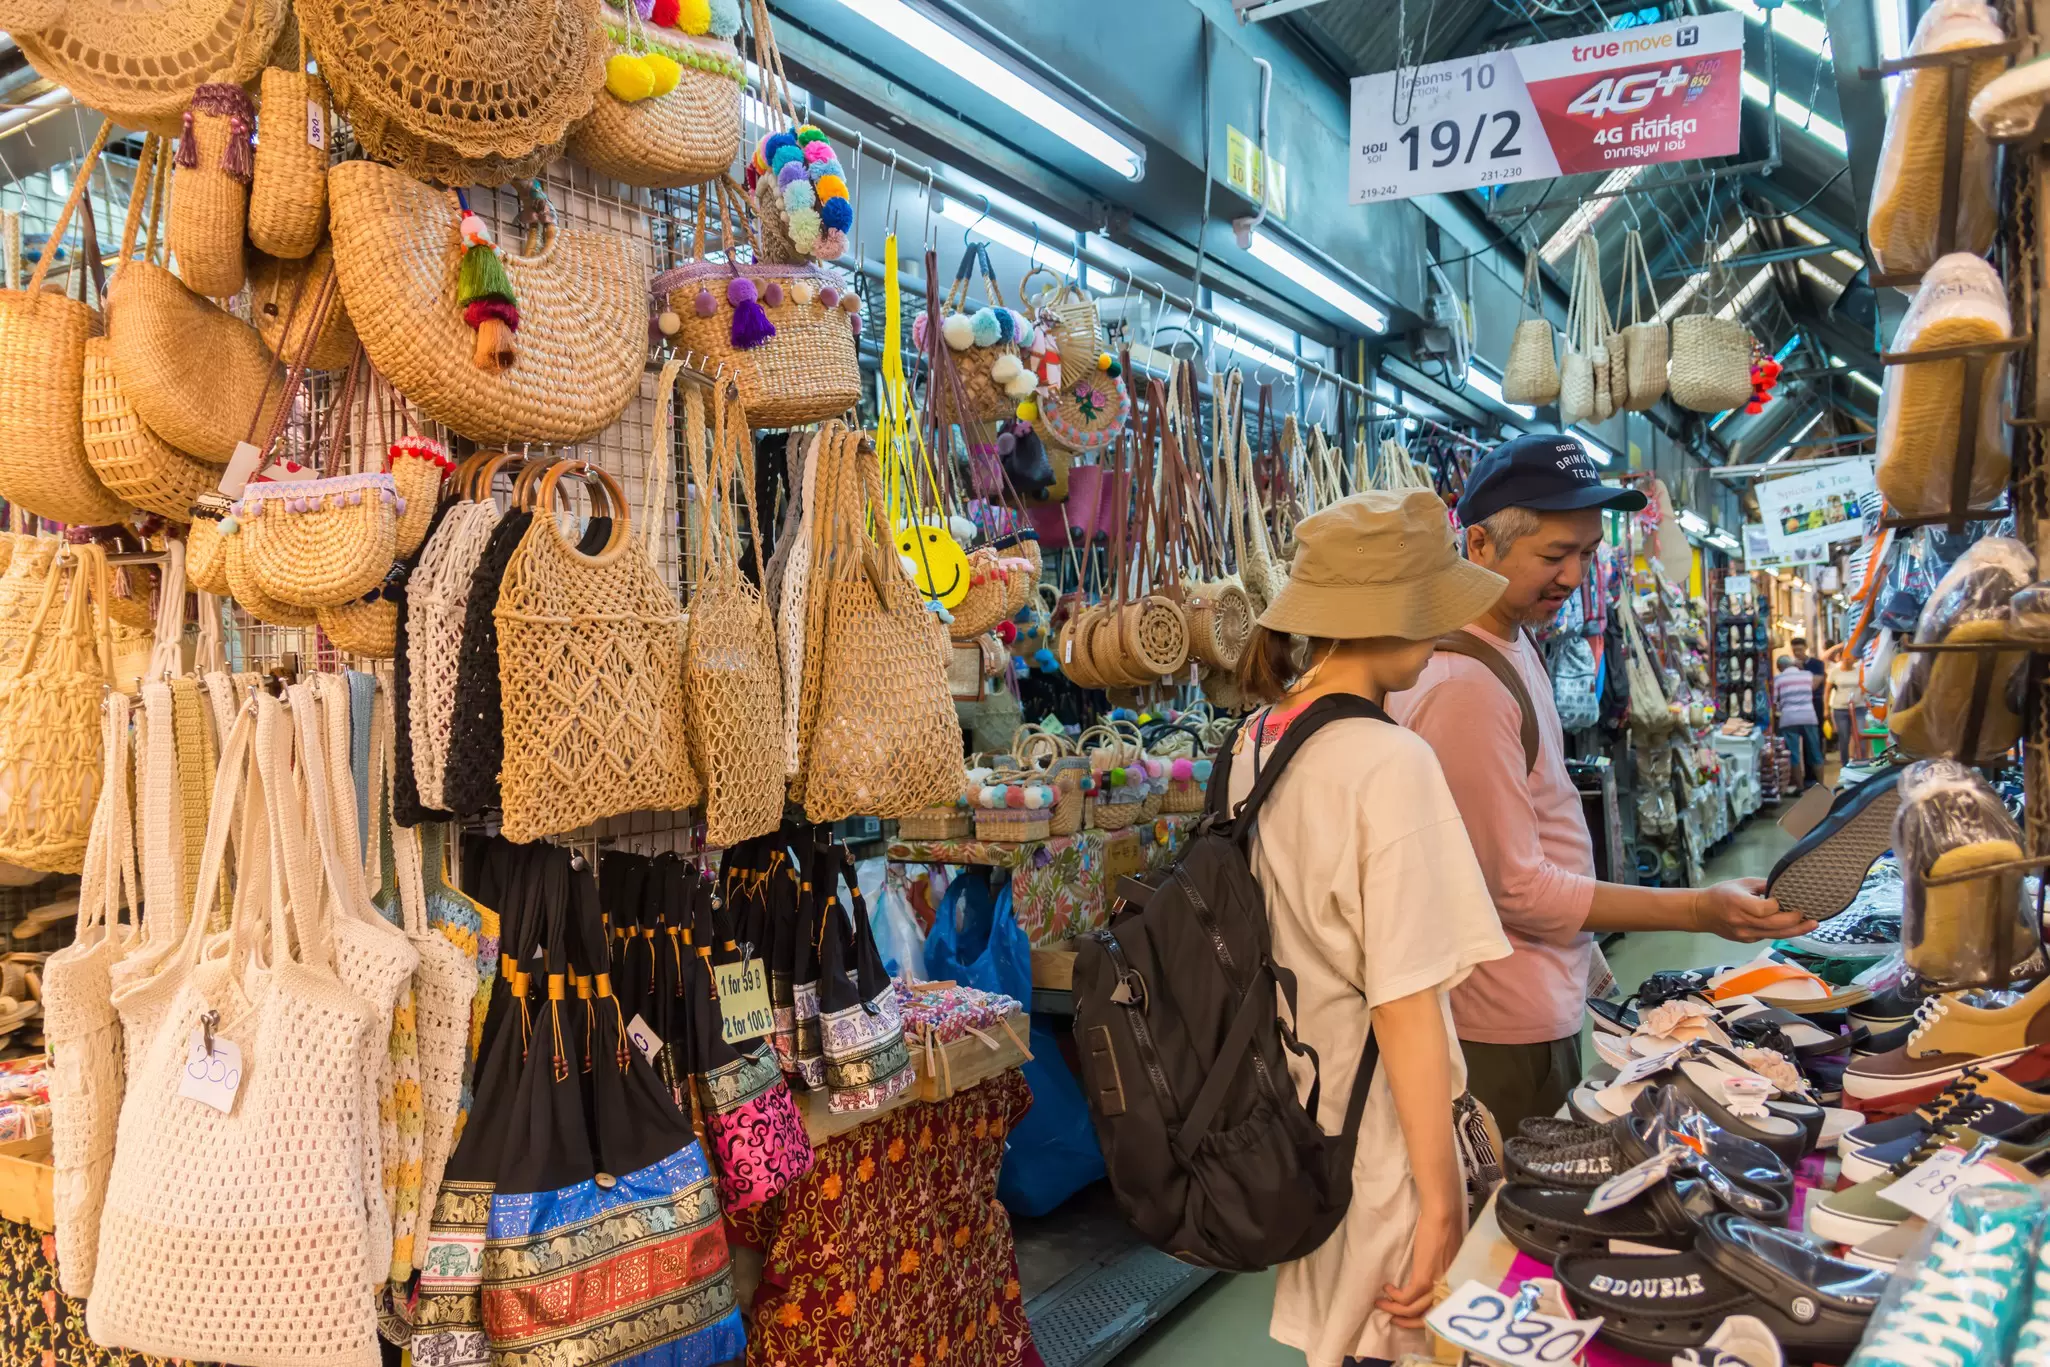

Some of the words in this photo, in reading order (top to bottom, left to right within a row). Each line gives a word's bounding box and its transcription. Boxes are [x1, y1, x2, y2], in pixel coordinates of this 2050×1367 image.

[1572, 42, 1619, 62] true
[1623, 34, 1672, 53] move
[1679, 27, 1697, 46] H
[1461, 63, 1495, 92] 10
[1399, 110, 1521, 171] 19/2
[1593, 127, 1623, 145] 4G
[1631, 114, 1697, 141] ที่ดีที่สุด
[1367, 155, 1382, 164] SOI
[1481, 167, 1522, 181] 231-230
[1360, 185, 1398, 198] 219-242
[721, 976, 726, 996] 1
[729, 974, 740, 995] for
[742, 970, 753, 992] 59
[755, 968, 761, 989] B
[724, 1017, 732, 1038] 2
[732, 1015, 746, 1036] for
[747, 1009, 765, 1032] 100
[764, 1007, 772, 1027] B
[188, 1044, 239, 1090] 350
[1541, 1156, 1612, 1174] DOUBLE
[1611, 1273, 1705, 1299] DOUBLE
[1448, 1295, 1586, 1362] 280
